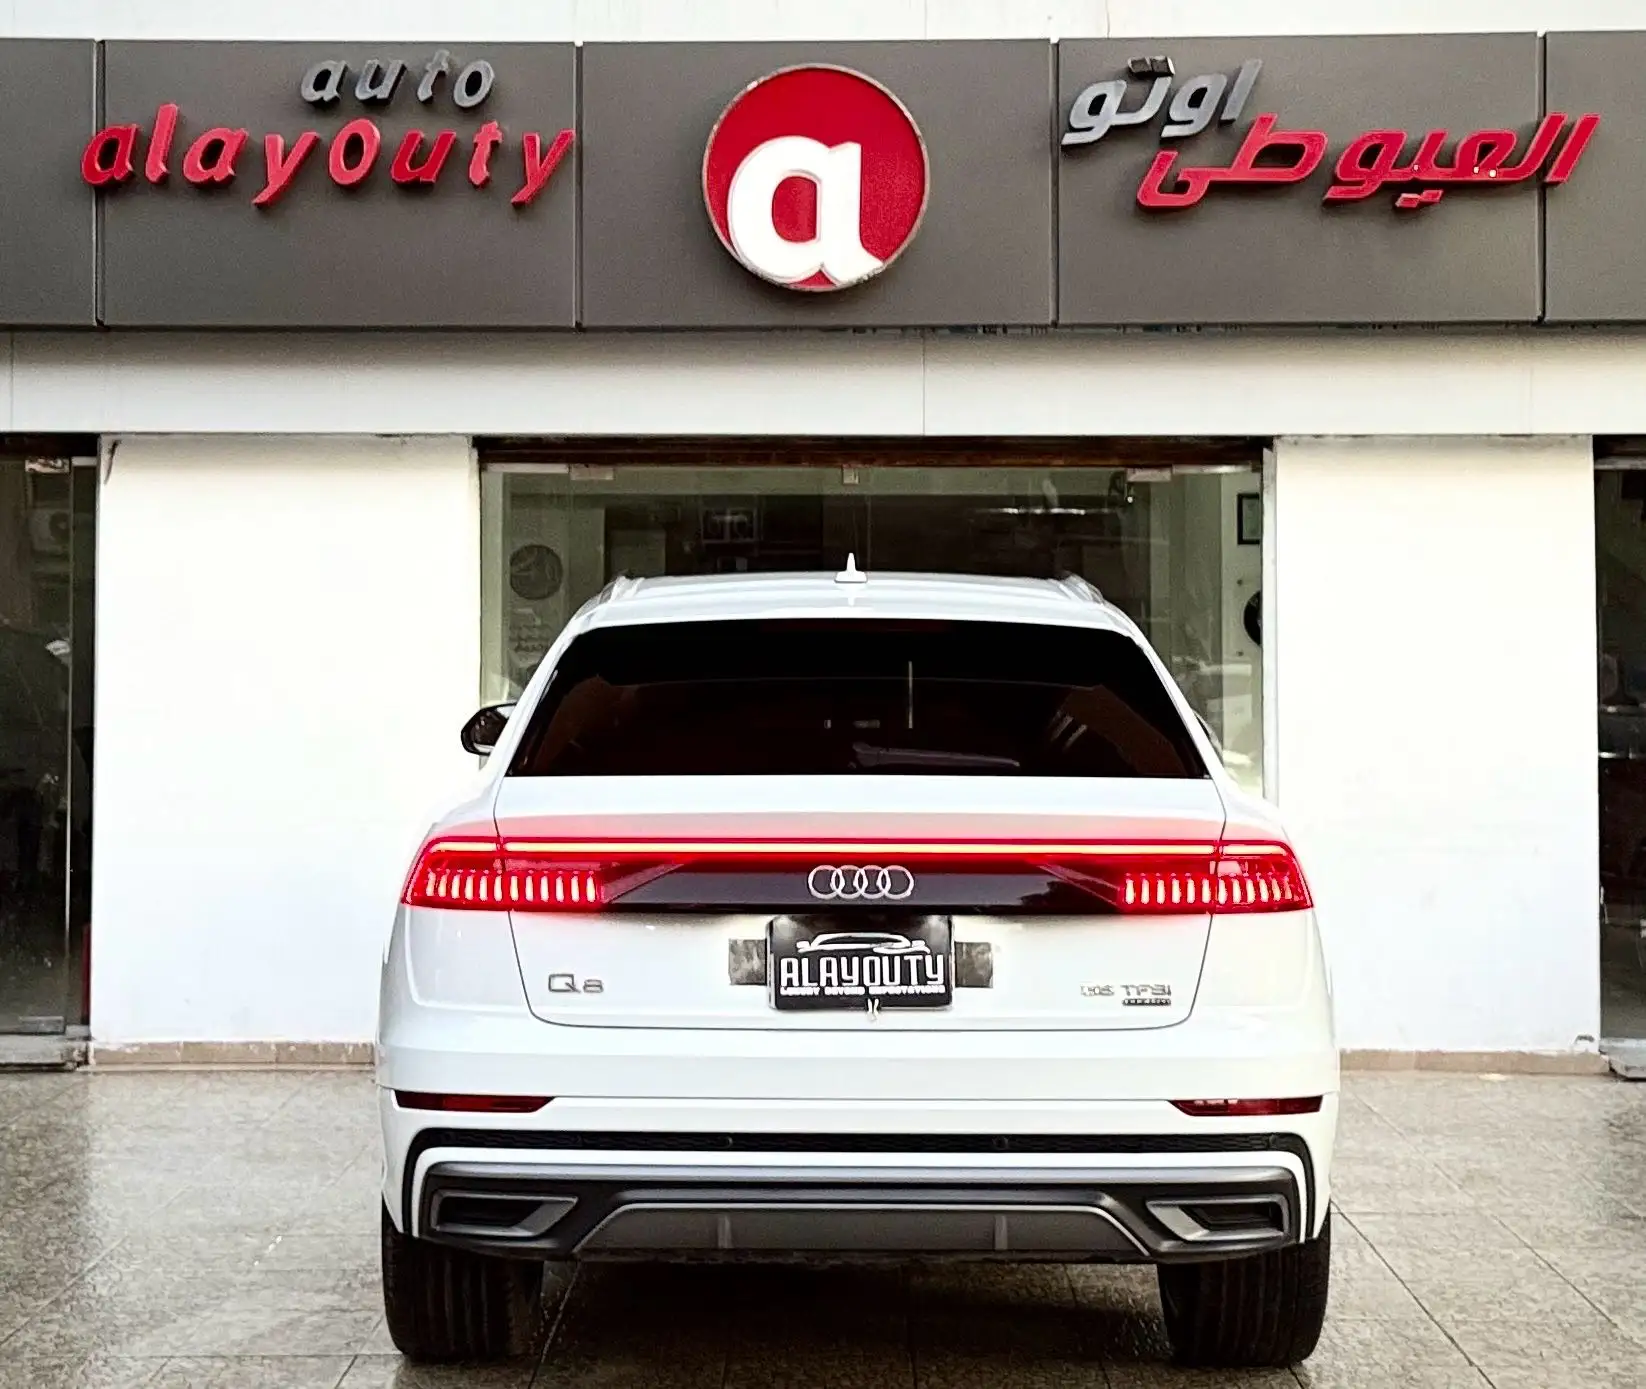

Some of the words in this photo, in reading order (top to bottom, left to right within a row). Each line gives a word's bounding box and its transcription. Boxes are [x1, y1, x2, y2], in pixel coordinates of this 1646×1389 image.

[301, 50, 496, 109] auto
[727, 135, 884, 284] a
[548, 973, 604, 993] Q8
[780, 954, 945, 987] ALAYOUTY
